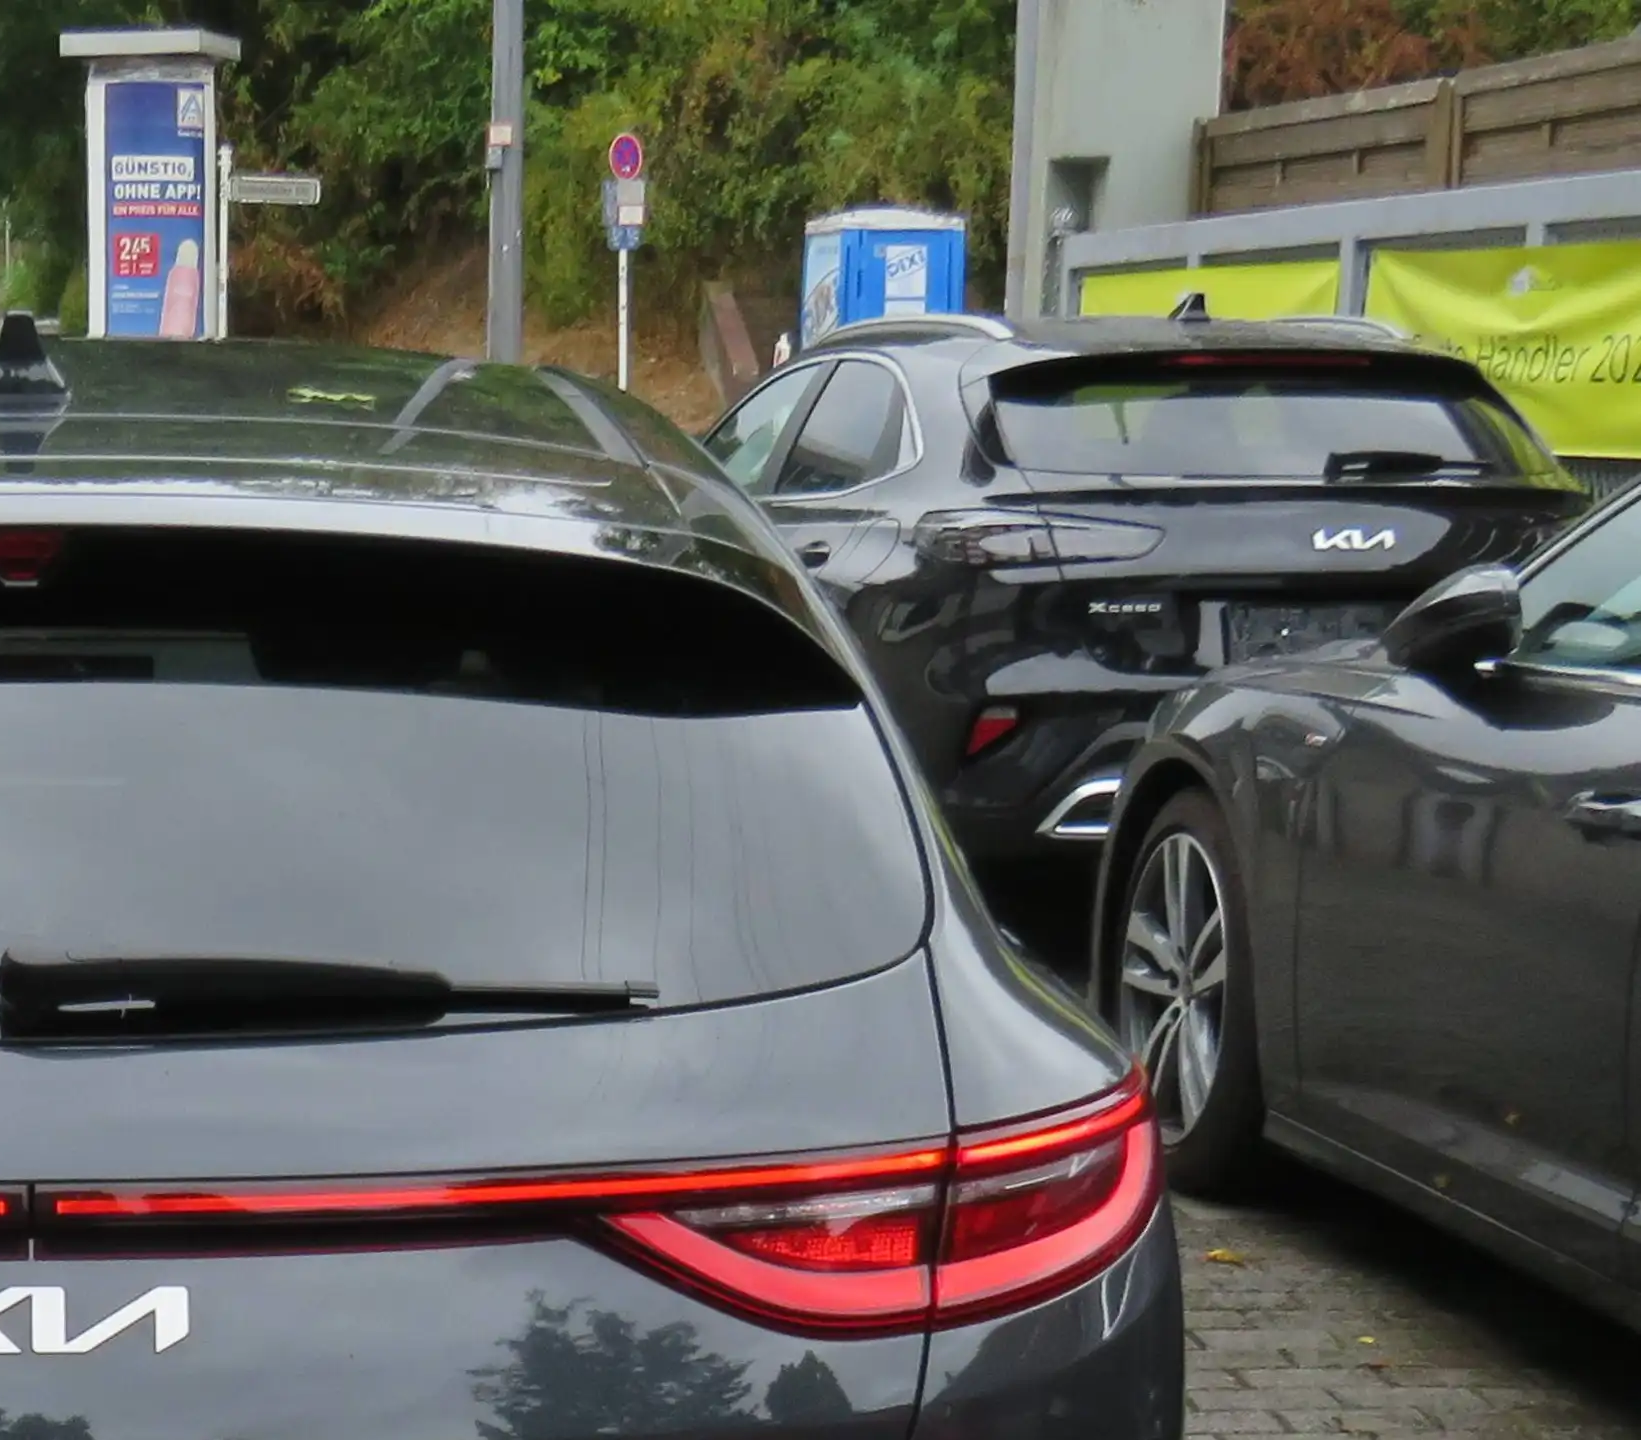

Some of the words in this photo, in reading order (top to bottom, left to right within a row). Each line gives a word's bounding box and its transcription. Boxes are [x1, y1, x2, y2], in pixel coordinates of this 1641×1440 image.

[114, 184, 160, 199] OHNE
[165, 184, 201, 199] APP!
[1476, 333, 1591, 383] Händler
[1313, 528, 1396, 550] KIA
